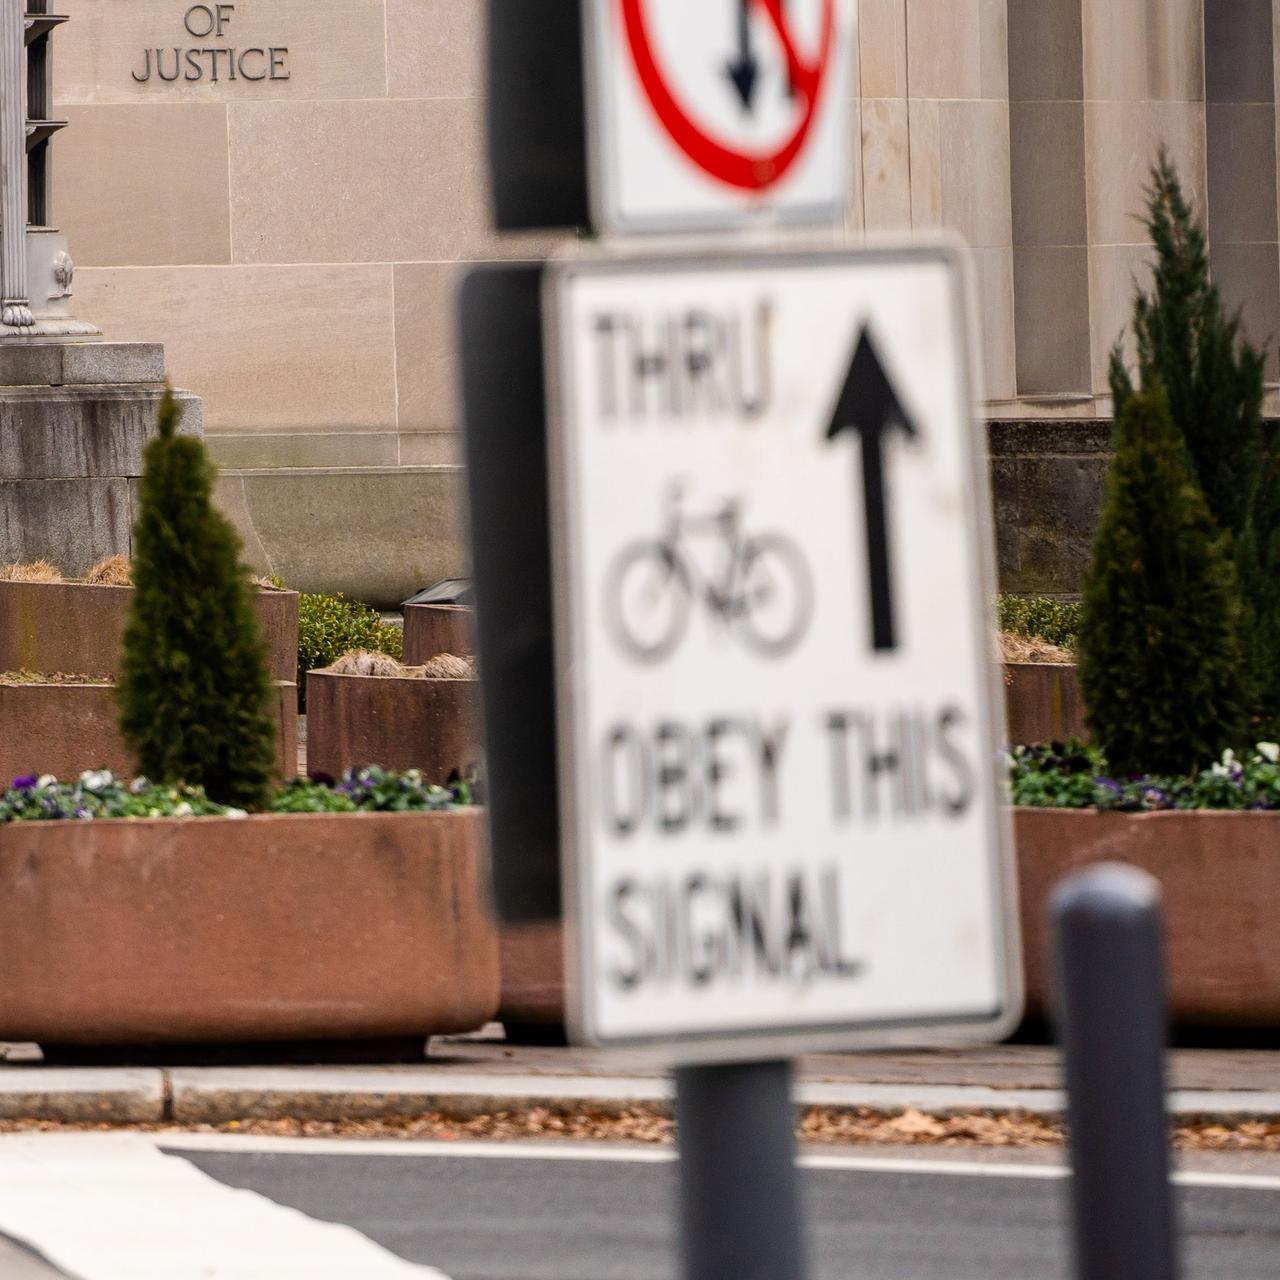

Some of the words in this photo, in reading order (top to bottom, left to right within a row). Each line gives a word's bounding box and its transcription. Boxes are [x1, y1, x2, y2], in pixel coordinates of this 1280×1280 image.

[131, 47, 291, 82] JUSTICE
[183, 4, 235, 38] OF
[593, 297, 775, 422] THRU
[603, 717, 790, 836] OBEY
[826, 705, 973, 827] THIS
[606, 867, 866, 991] SIGNAL
